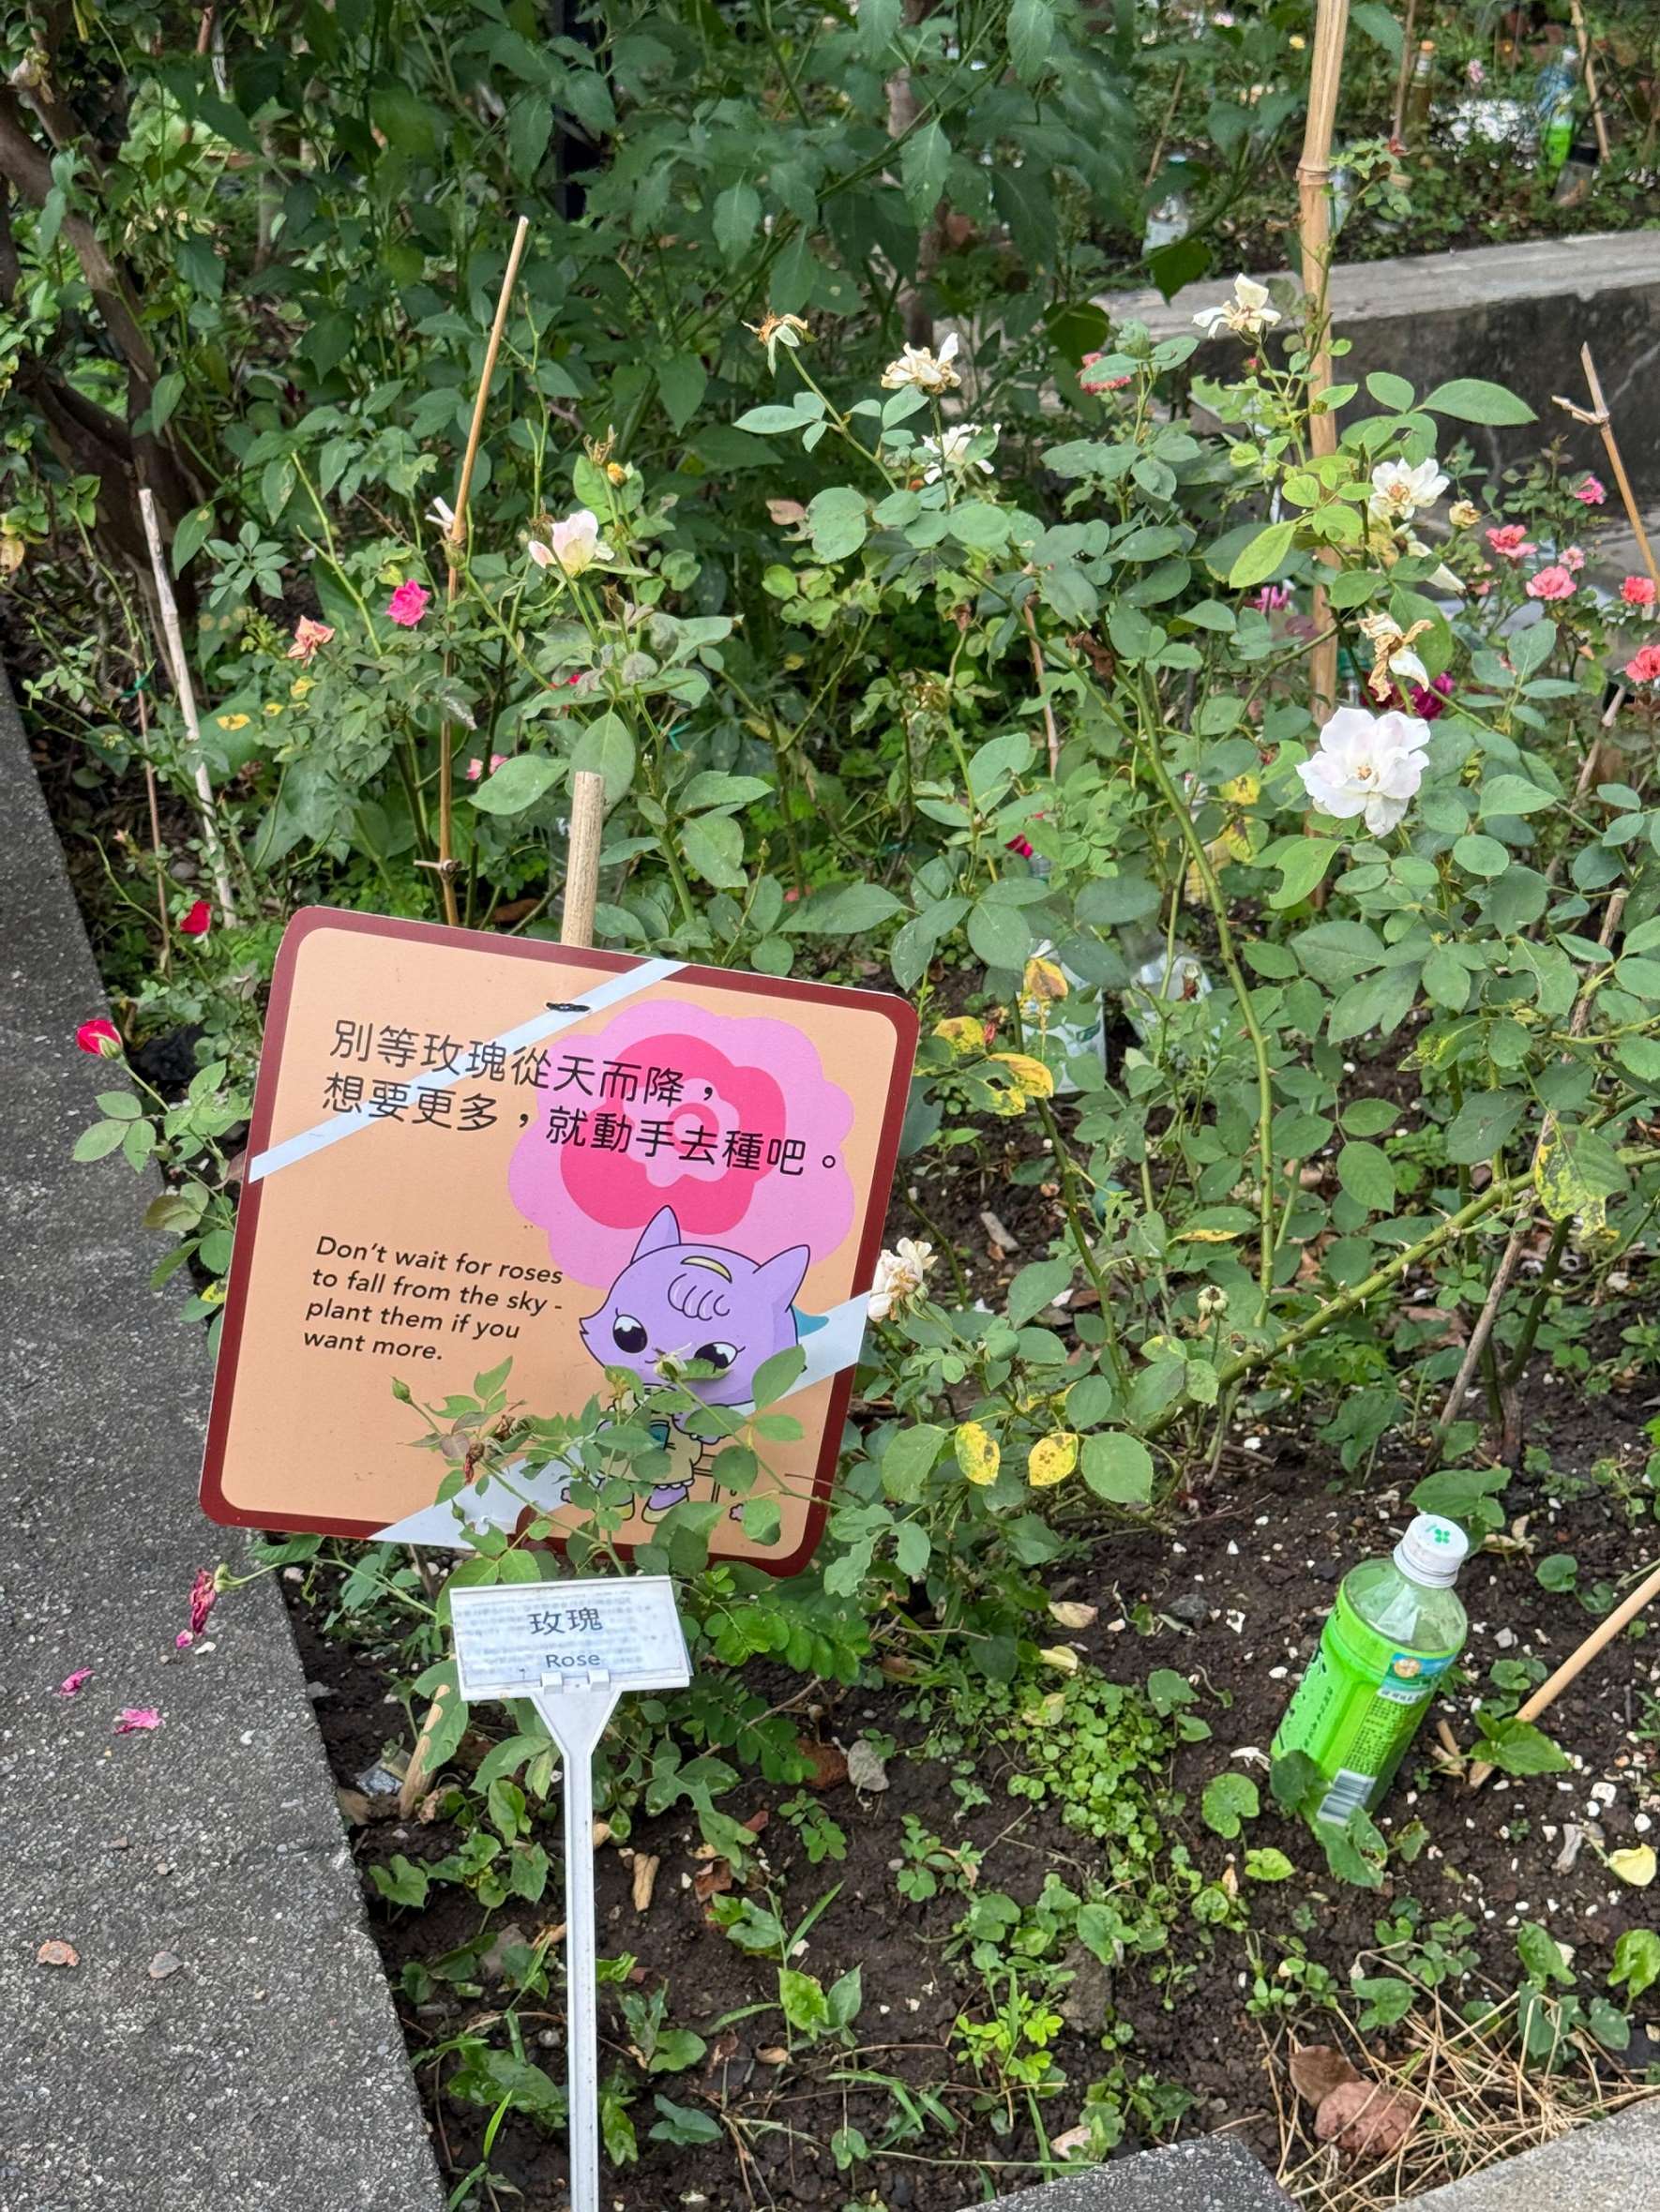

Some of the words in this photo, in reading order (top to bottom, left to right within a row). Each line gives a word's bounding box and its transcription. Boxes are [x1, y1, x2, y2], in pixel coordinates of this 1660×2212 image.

[330, 1019, 713, 1107] 別等玫瑰從天而降，
[322, 1071, 836, 1176] 想要更多，就動手去種吧。
[316, 1236, 387, 1263] Don't
[395, 1251, 447, 1271] wait
[456, 1253, 492, 1275] for
[499, 1264, 563, 1284] roses
[311, 1268, 338, 1287] to
[347, 1271, 386, 1293] fall
[393, 1276, 450, 1302] from
[460, 1285, 499, 1306] the
[506, 1291, 548, 1317] sky
[305, 1298, 372, 1322] plant
[380, 1306, 443, 1330] them
[451, 1314, 471, 1333] if
[473, 1321, 520, 1340] you
[303, 1332, 366, 1352] want
[371, 1340, 443, 1360] more.
[528, 1606, 603, 1635] 玫瑰
[546, 1654, 600, 1668] Rose
